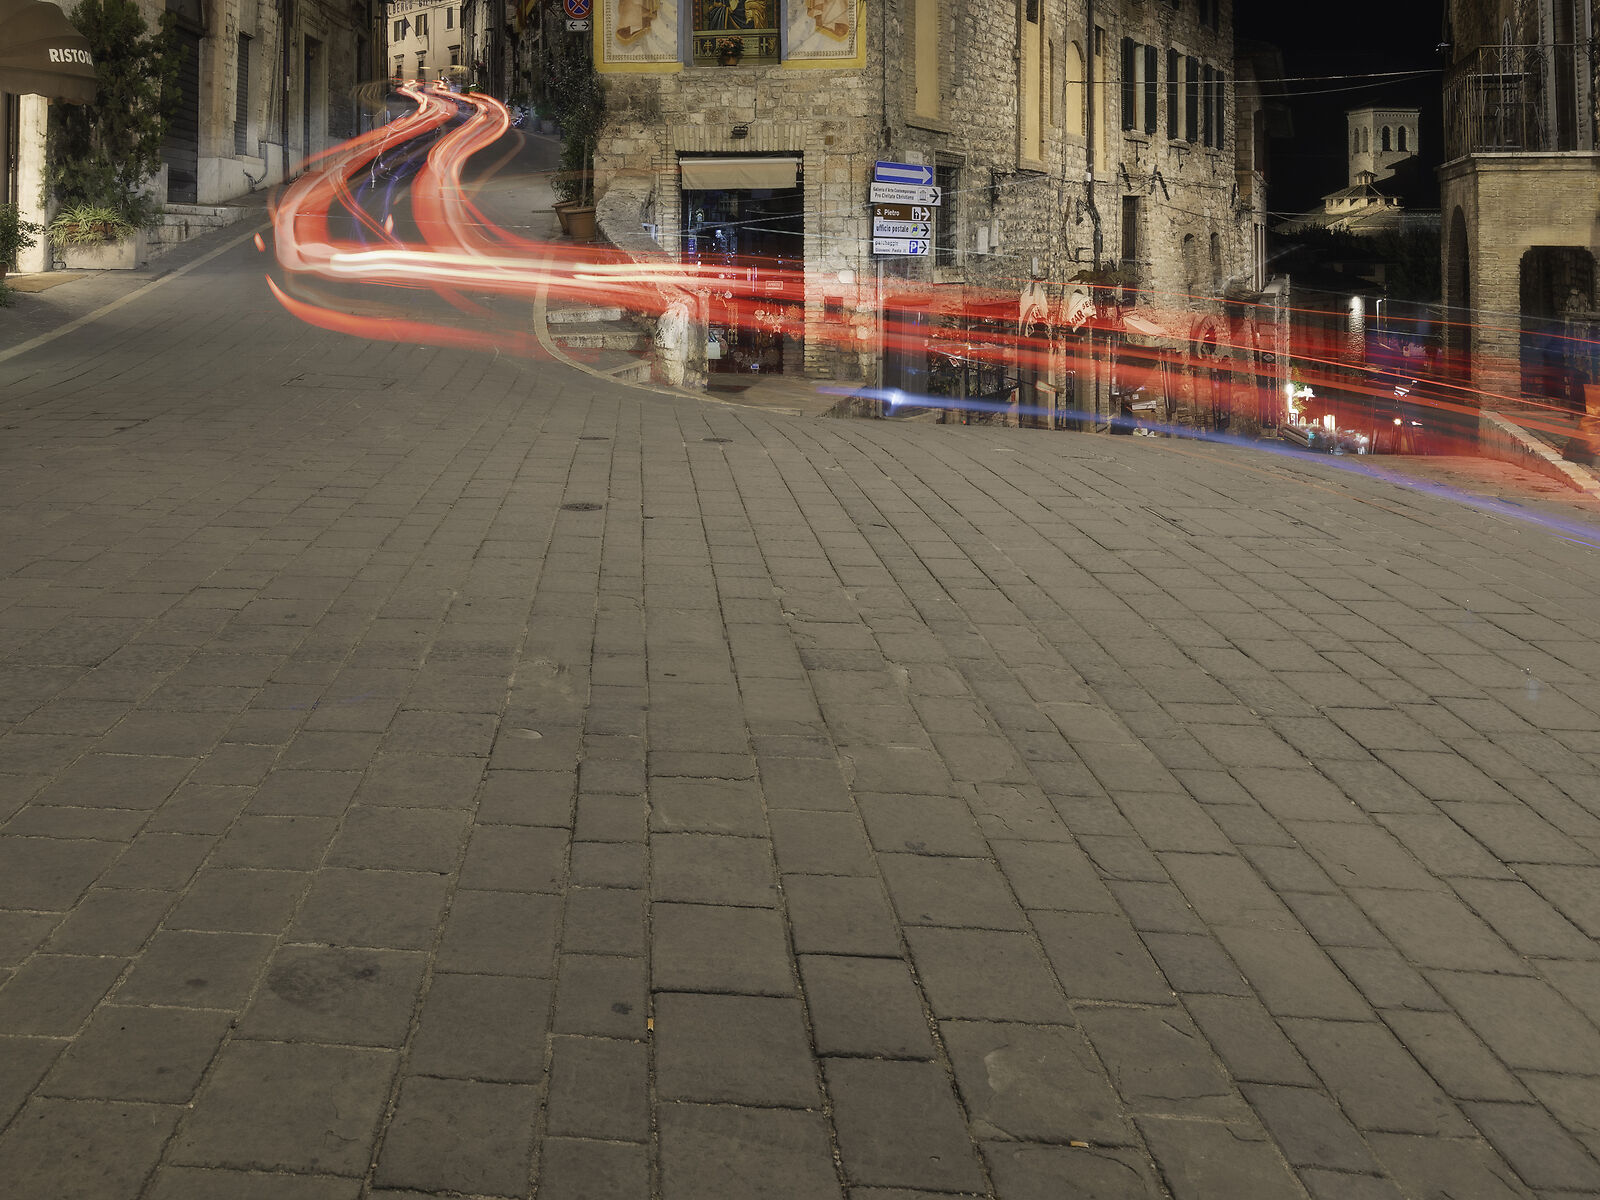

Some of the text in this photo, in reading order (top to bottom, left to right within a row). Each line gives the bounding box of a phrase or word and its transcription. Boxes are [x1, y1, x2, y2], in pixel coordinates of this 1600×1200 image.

[388, 0, 413, 16] LBERGO
[876, 208, 900, 217] S. Pietro
[876, 224, 891, 232] ufficio
[892, 224, 909, 234] postale
